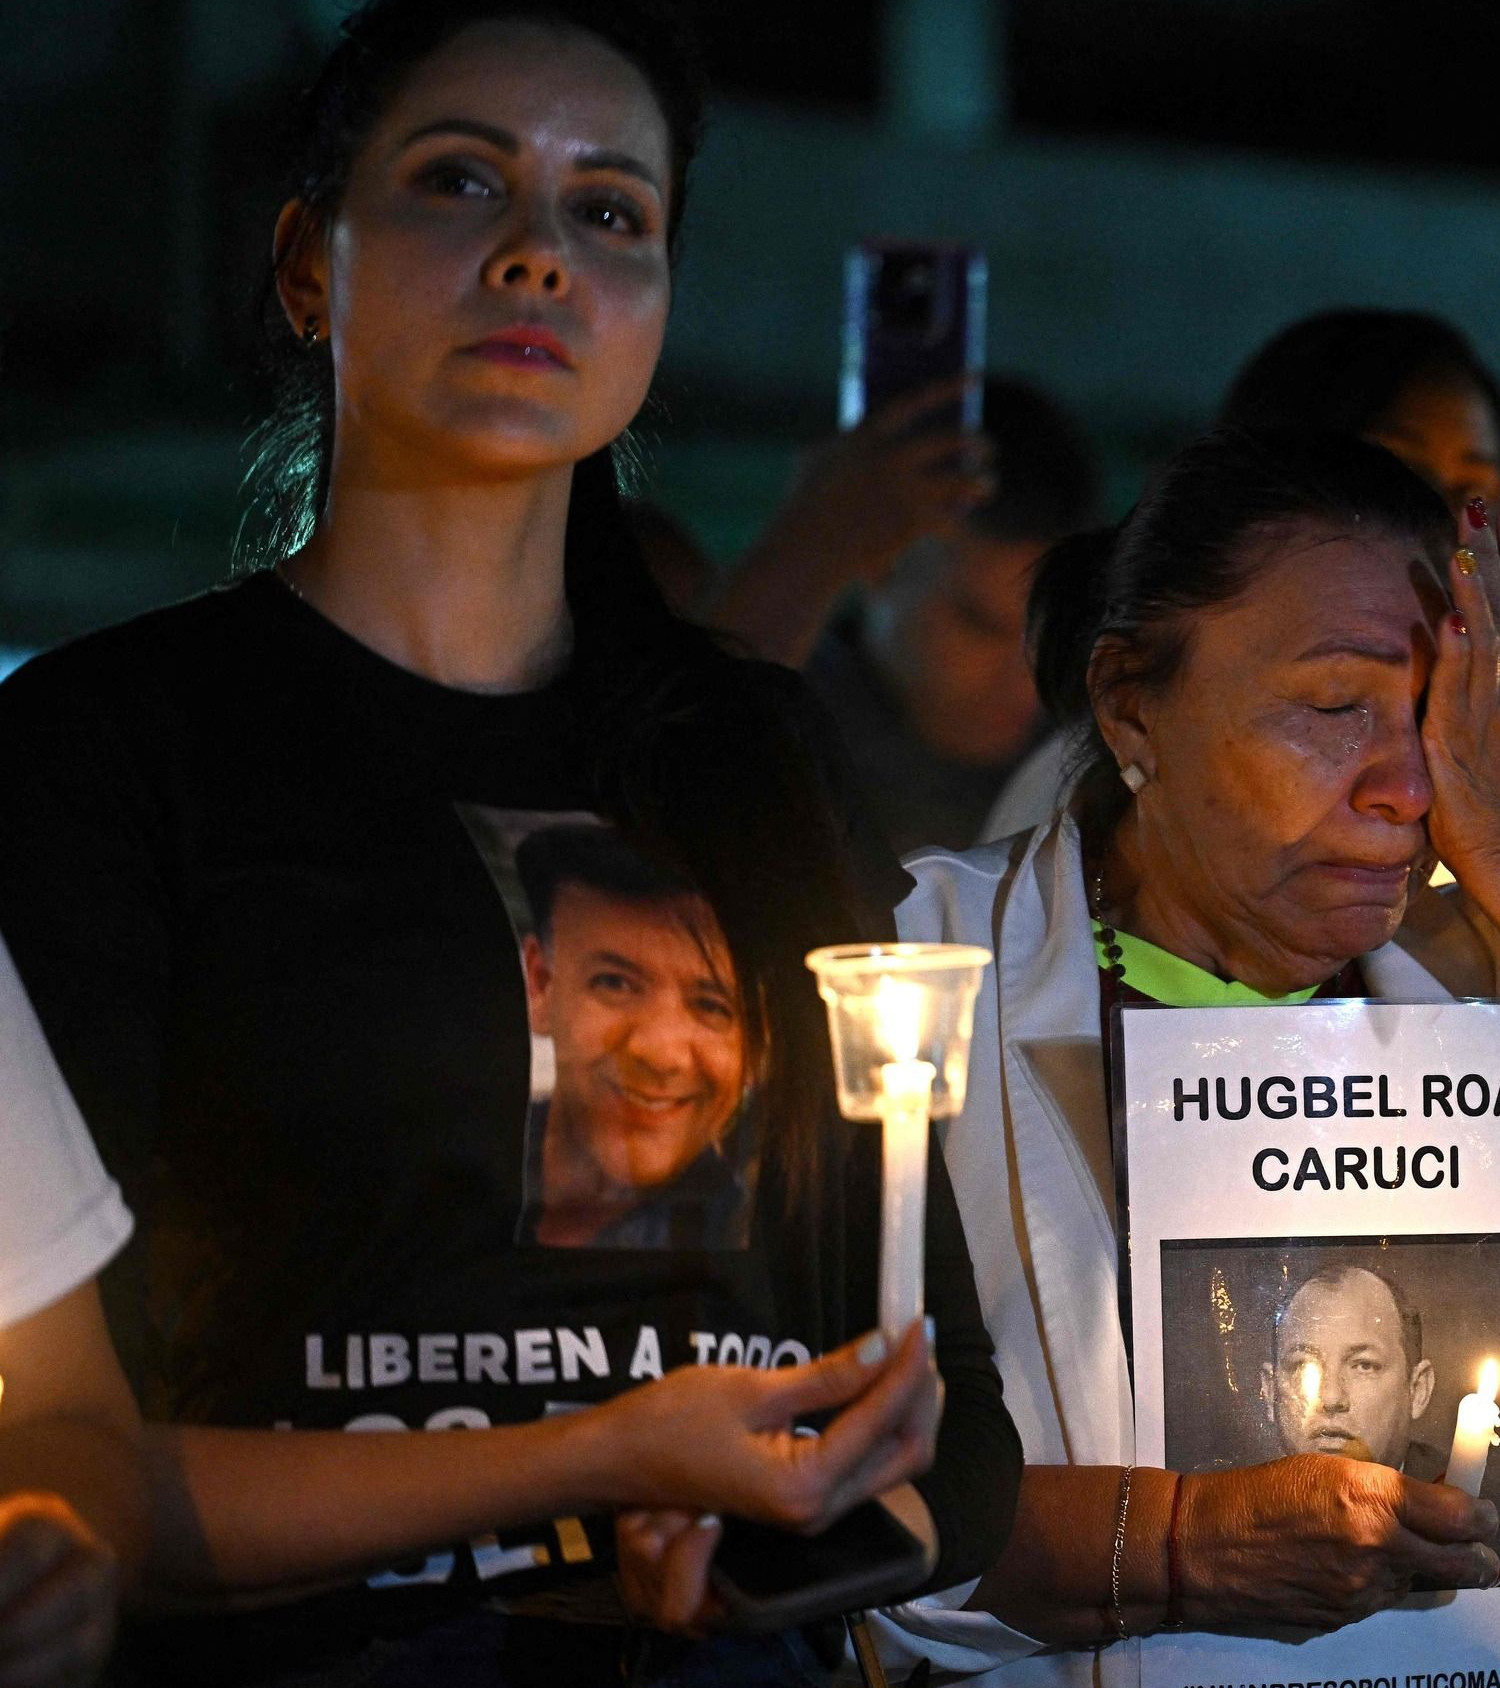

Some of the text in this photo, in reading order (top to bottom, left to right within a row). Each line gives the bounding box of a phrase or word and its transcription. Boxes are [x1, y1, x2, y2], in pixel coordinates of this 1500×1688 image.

[1172, 1074, 1407, 1122] HUGBEL
[1251, 1145, 1460, 1192] CARUCI
[304, 1324, 824, 1391] LIBEREN A TODO
